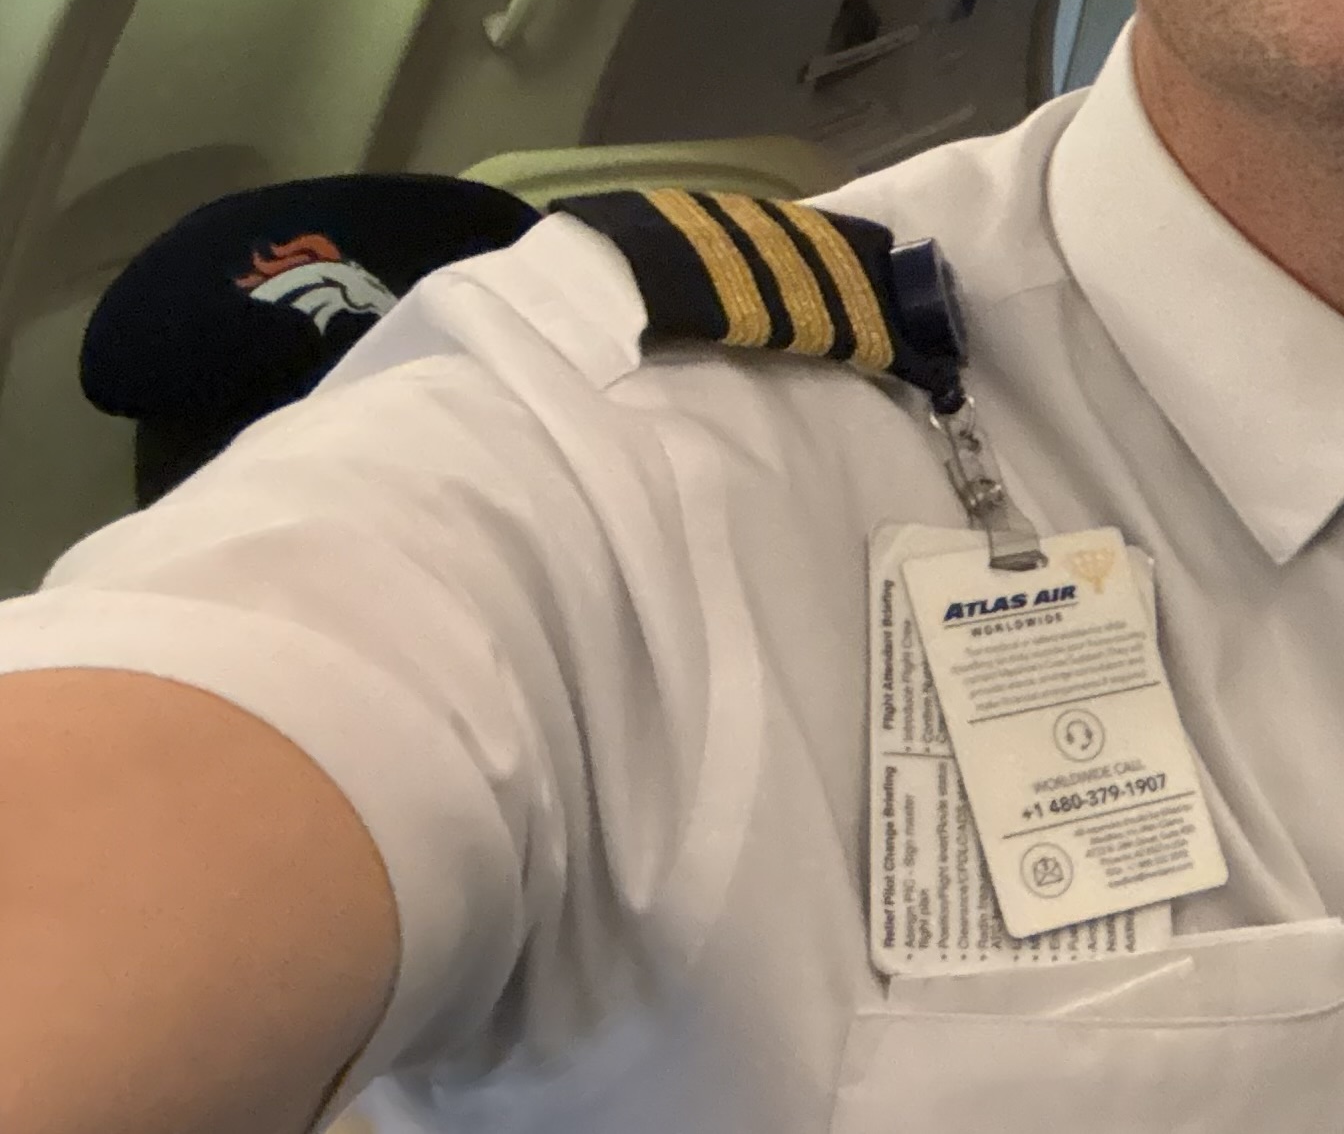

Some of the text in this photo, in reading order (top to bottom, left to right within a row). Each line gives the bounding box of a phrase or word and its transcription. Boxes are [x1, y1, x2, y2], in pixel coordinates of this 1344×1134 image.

[943, 585, 1077, 621] ATLAS AIR
[971, 612, 1063, 637] WORLDWIDE
[882, 580, 895, 729] Flight Attendant Briefing
[1022, 773, 1166, 819] +1 480-379-1907
[1033, 759, 1145, 793] WORLDWIDE CALL
[883, 766, 896, 948] Relief Pilot Change Briefing
